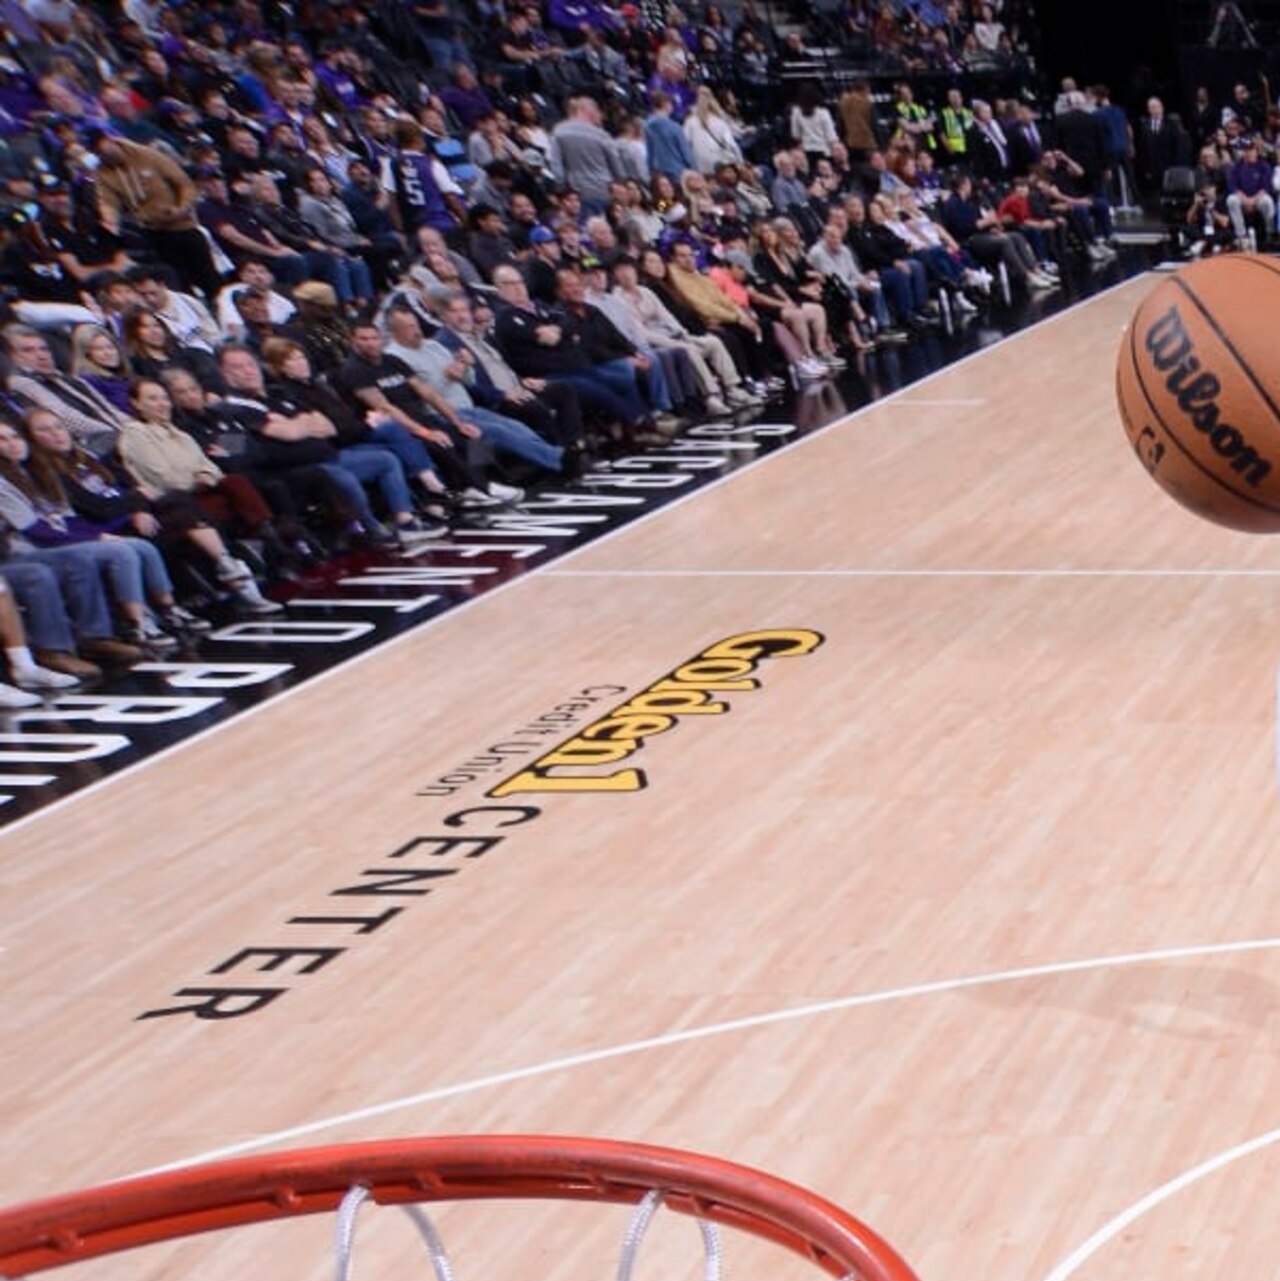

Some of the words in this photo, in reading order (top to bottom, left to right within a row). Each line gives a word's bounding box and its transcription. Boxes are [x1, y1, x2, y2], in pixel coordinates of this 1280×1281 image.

[1145, 304, 1274, 488] Wilson
[210, 423, 797, 642] SACRAMENTO
[0, 662, 296, 806] PRO
[416, 736, 544, 799] Union
[519, 684, 629, 738] Credit
[533, 627, 827, 768] Golden
[485, 765, 648, 799] 1
[136, 804, 544, 1023] CENTER
